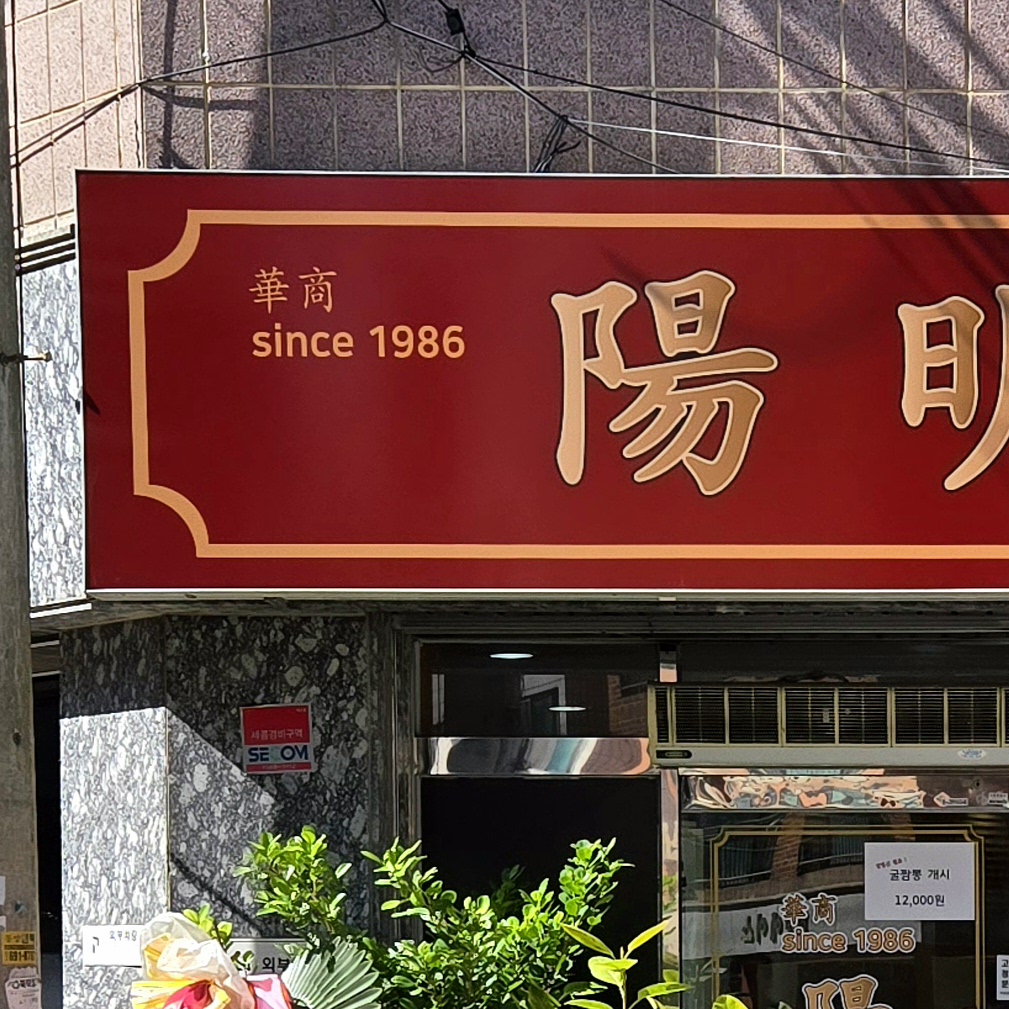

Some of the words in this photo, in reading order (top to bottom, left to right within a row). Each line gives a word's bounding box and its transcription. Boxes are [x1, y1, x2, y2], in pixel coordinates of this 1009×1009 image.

[249, 266, 336, 313] 華商
[252, 324, 353, 358] since
[370, 325, 465, 358] 1986
[248, 745, 308, 762] SECOM
[889, 868, 922, 881] 굴짬뽕
[927, 868, 950, 880] 개시
[782, 893, 836, 924] 華商
[895, 894, 945, 908] 12,000원
[782, 928, 847, 952] since
[853, 928, 916, 952] 1986
